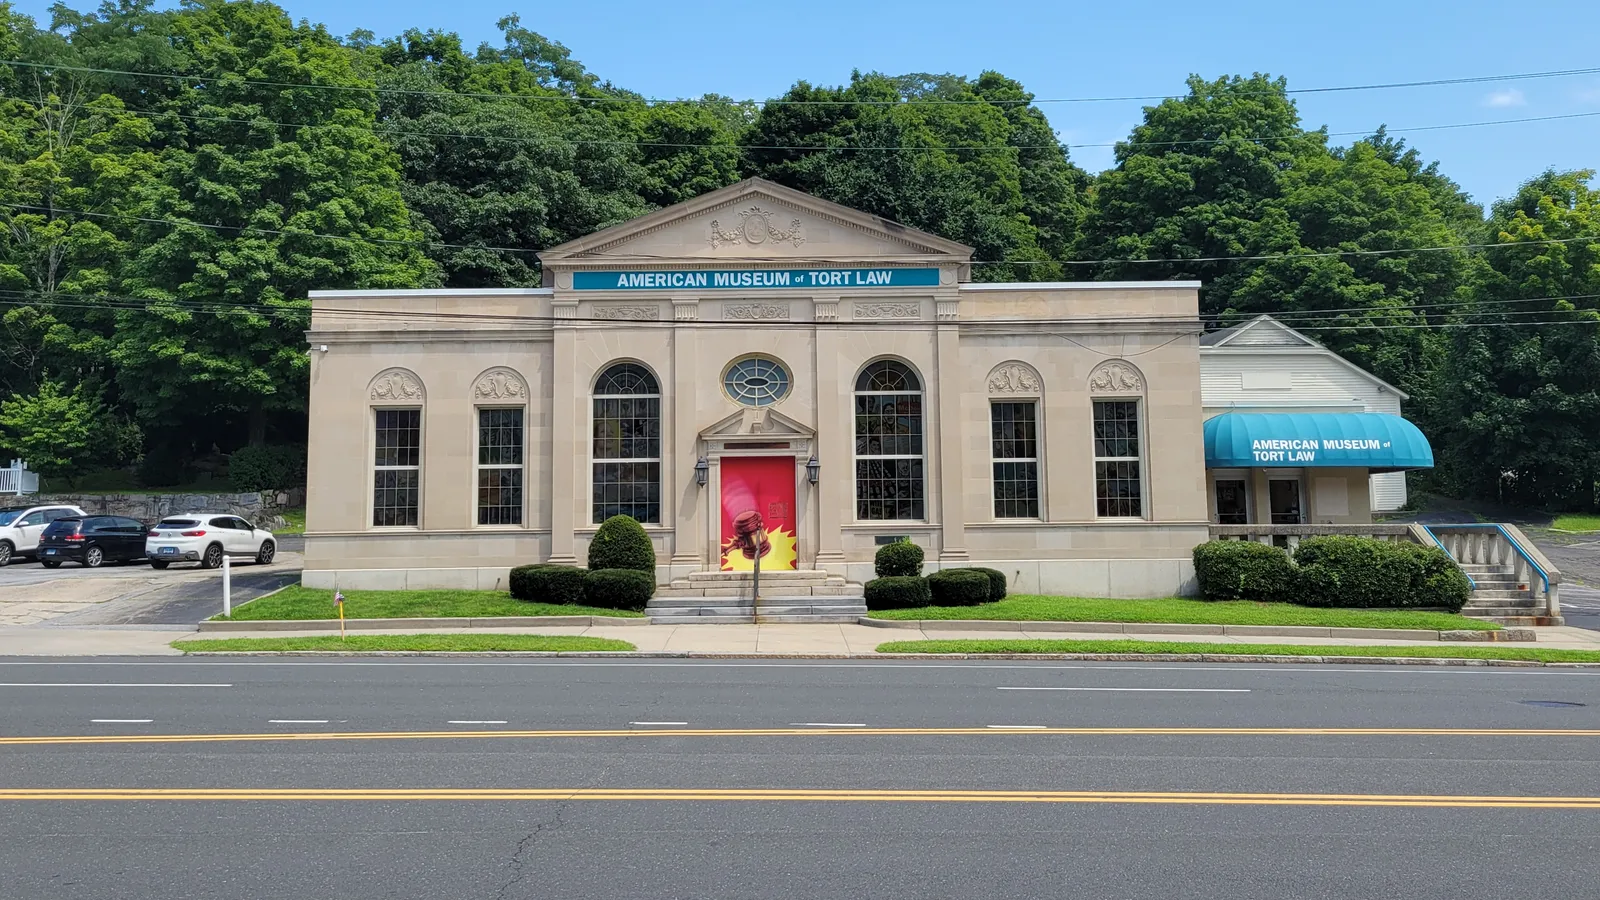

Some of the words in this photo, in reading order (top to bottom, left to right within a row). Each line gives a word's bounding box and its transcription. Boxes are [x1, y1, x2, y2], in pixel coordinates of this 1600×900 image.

[617, 273, 707, 287] AMERICAN
[714, 273, 790, 286] MUSEUM
[794, 274, 804, 283] of
[808, 271, 851, 285] TORT
[855, 271, 893, 285] LAW
[1252, 439, 1319, 450] AMERICAN
[1323, 439, 1380, 450] MUSEUM
[1253, 451, 1285, 462] TORT
[1288, 451, 1315, 462] LAW
